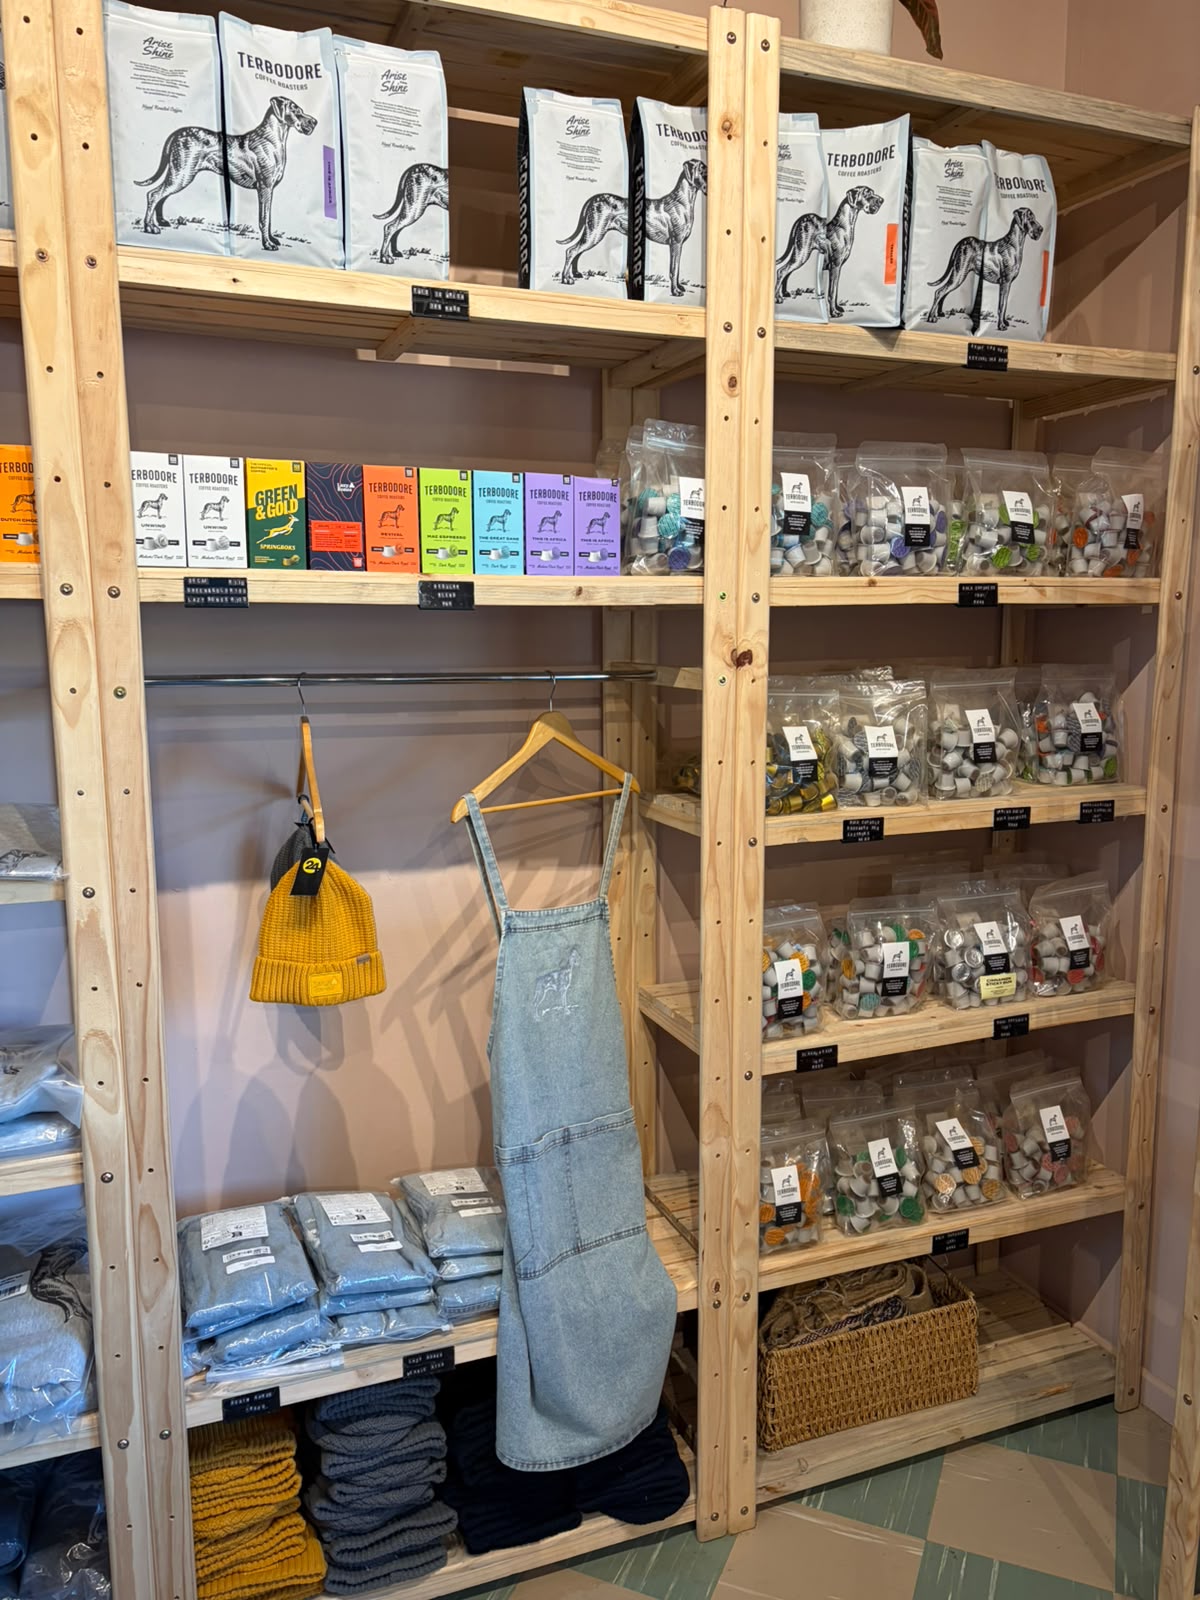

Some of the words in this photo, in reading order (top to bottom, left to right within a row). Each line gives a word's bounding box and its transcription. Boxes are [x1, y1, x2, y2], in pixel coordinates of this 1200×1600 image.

[142, 36, 173, 49] Arise
[142, 45, 174, 59] Shine
[237, 51, 322, 80] TERBODORE
[255, 73, 276, 86] COFFEE
[278, 81, 308, 91] ROASTERS
[381, 69, 407, 81] Arise
[380, 80, 408, 95] Shine
[566, 115, 590, 125] Arise
[565, 124, 591, 138] Shine
[655, 123, 708, 143] TERBODO
[827, 144, 895, 167] TERBODORE
[944, 158, 964, 168] Arise
[944, 167, 965, 182] Shine
[994, 172, 1047, 192] ERBODORE
[0, 461, 34, 473] TERBOD
[131, 469, 178, 484] ERBODORE
[189, 472, 239, 486] TERBODORE
[254, 483, 298, 507] GREEN
[369, 482, 413, 495] TERBODORE
[424, 484, 467, 498] TERBODORE
[478, 487, 519, 500] TERBODORE
[530, 488, 570, 501] TERBODORE
[579, 490, 617, 503] TERBODORE
[255, 504, 266, 521] &
[266, 498, 299, 518] GOLD
[260, 543, 296, 551] SPRINGBOKS
